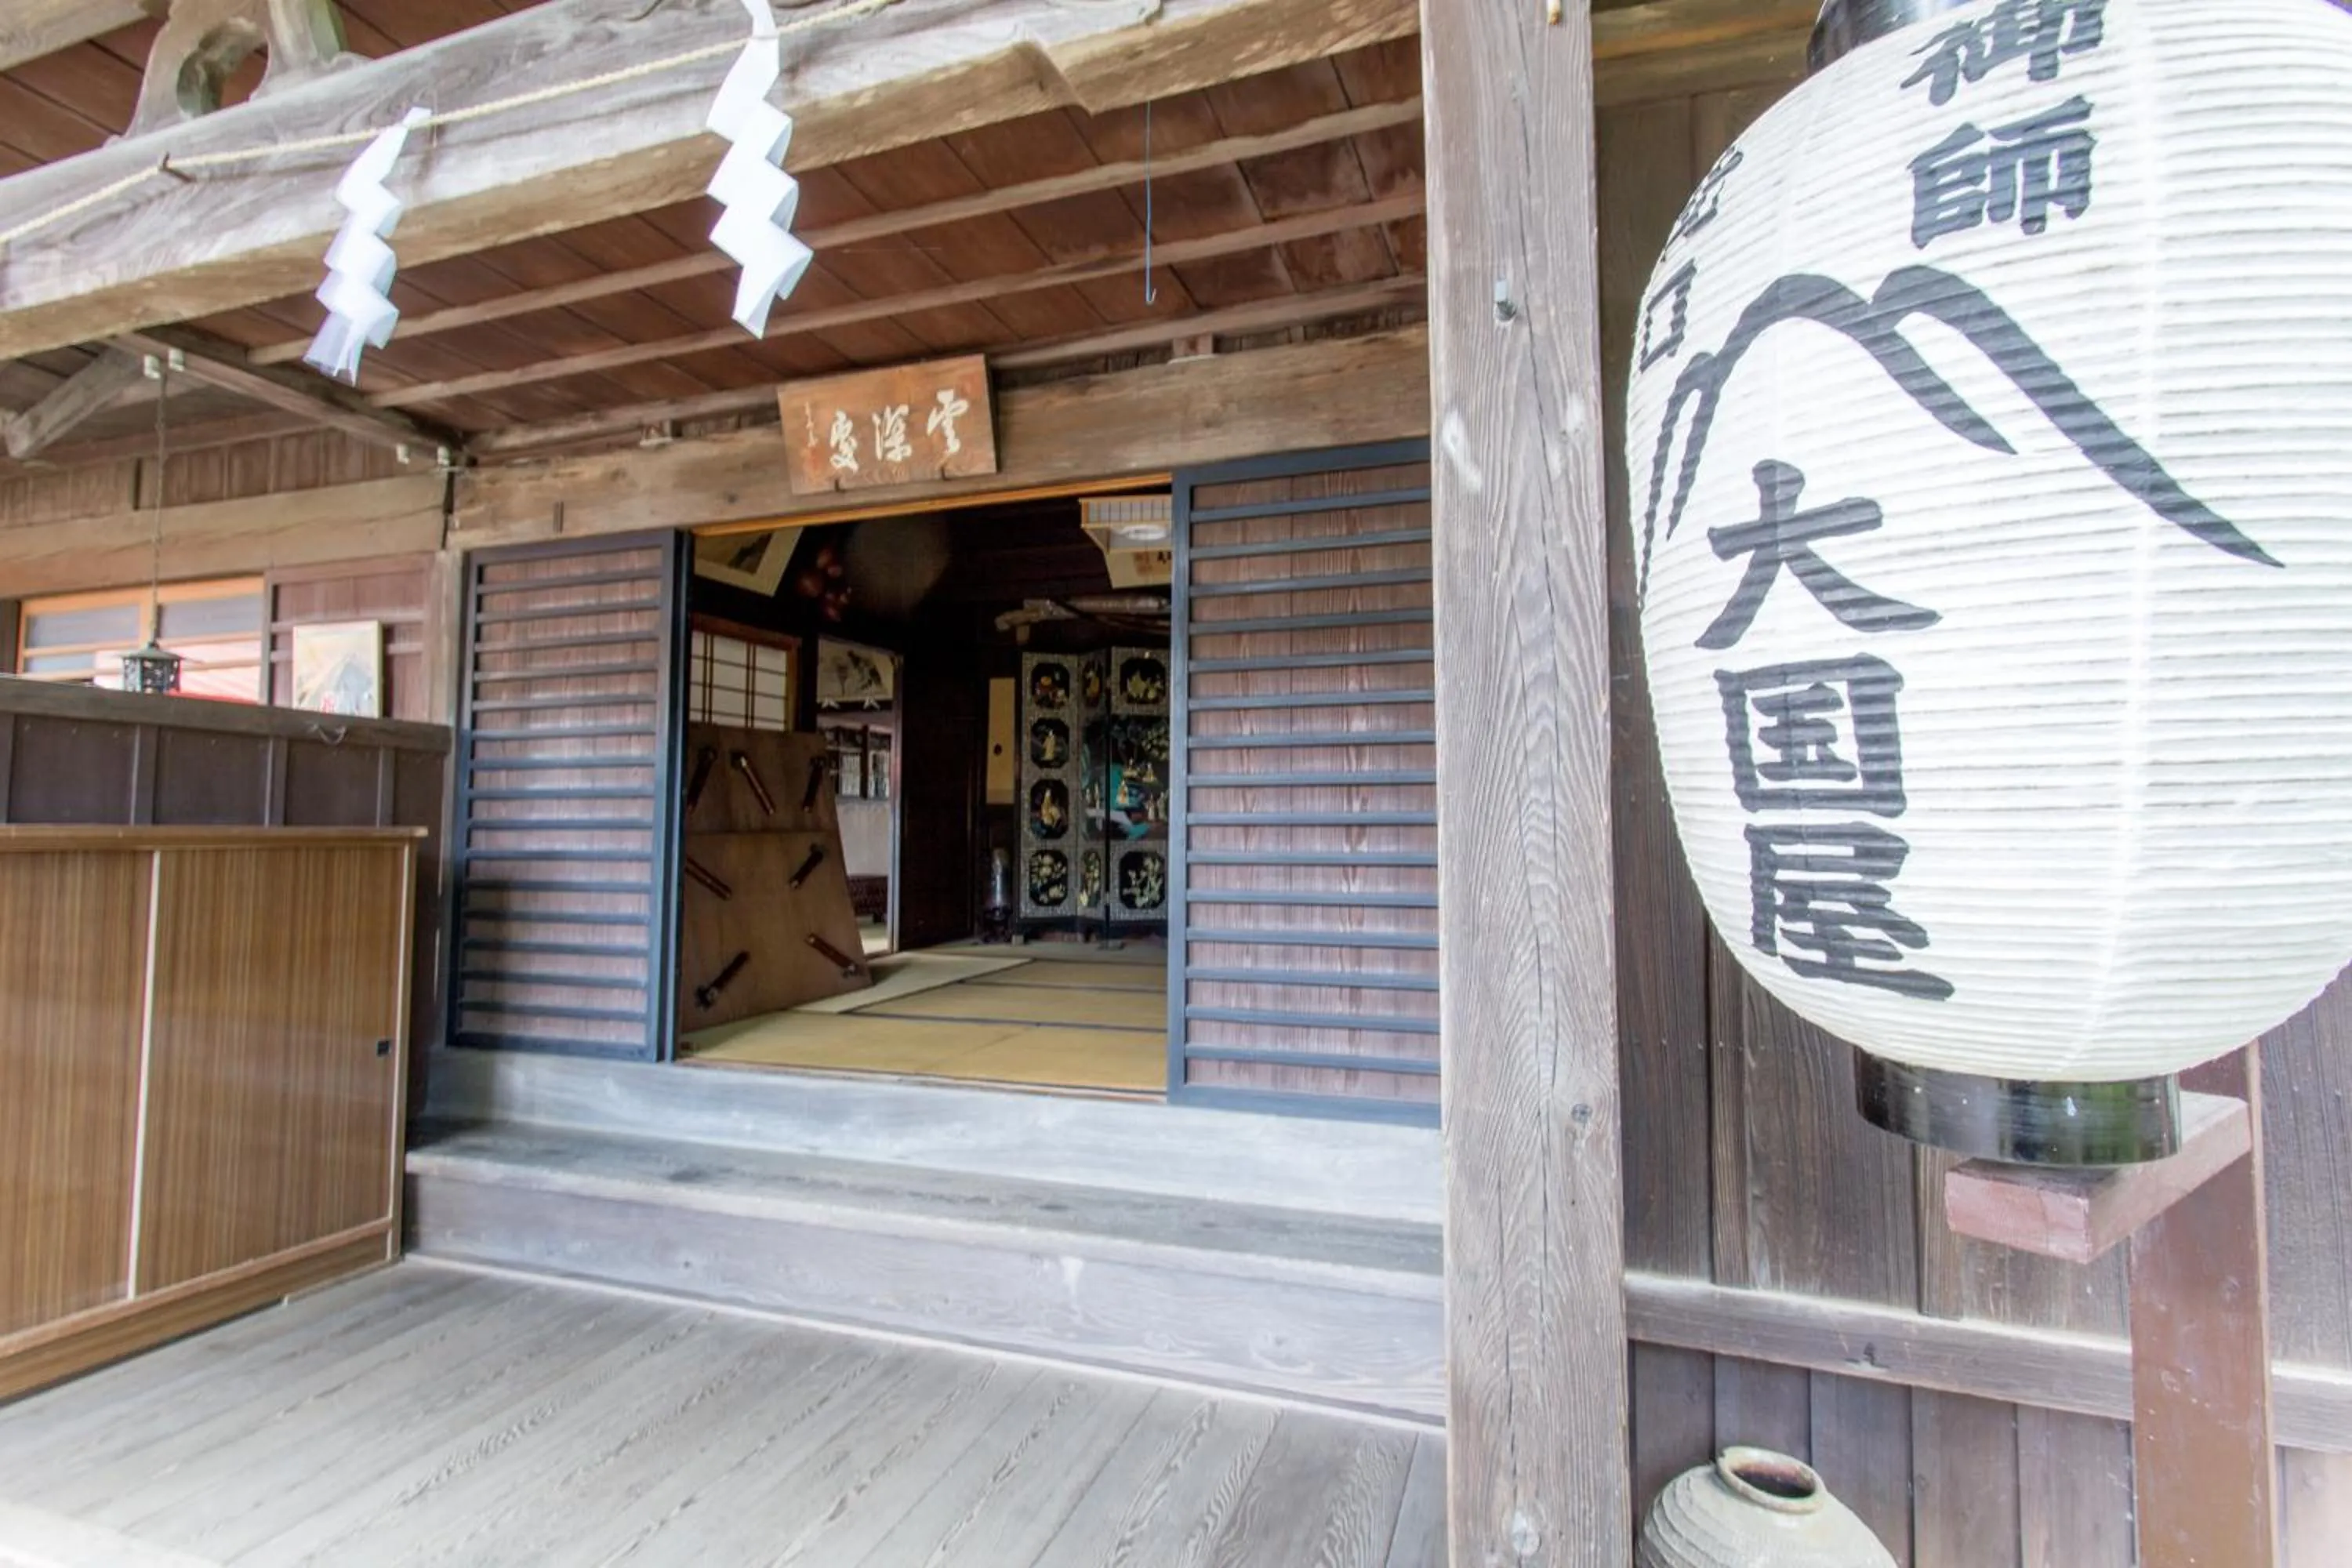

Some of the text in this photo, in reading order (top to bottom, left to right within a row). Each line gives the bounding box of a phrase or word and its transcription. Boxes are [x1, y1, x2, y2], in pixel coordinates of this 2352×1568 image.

[1900, 0, 2109, 249] 御師
[1693, 458, 1955, 1001] 大国屋
